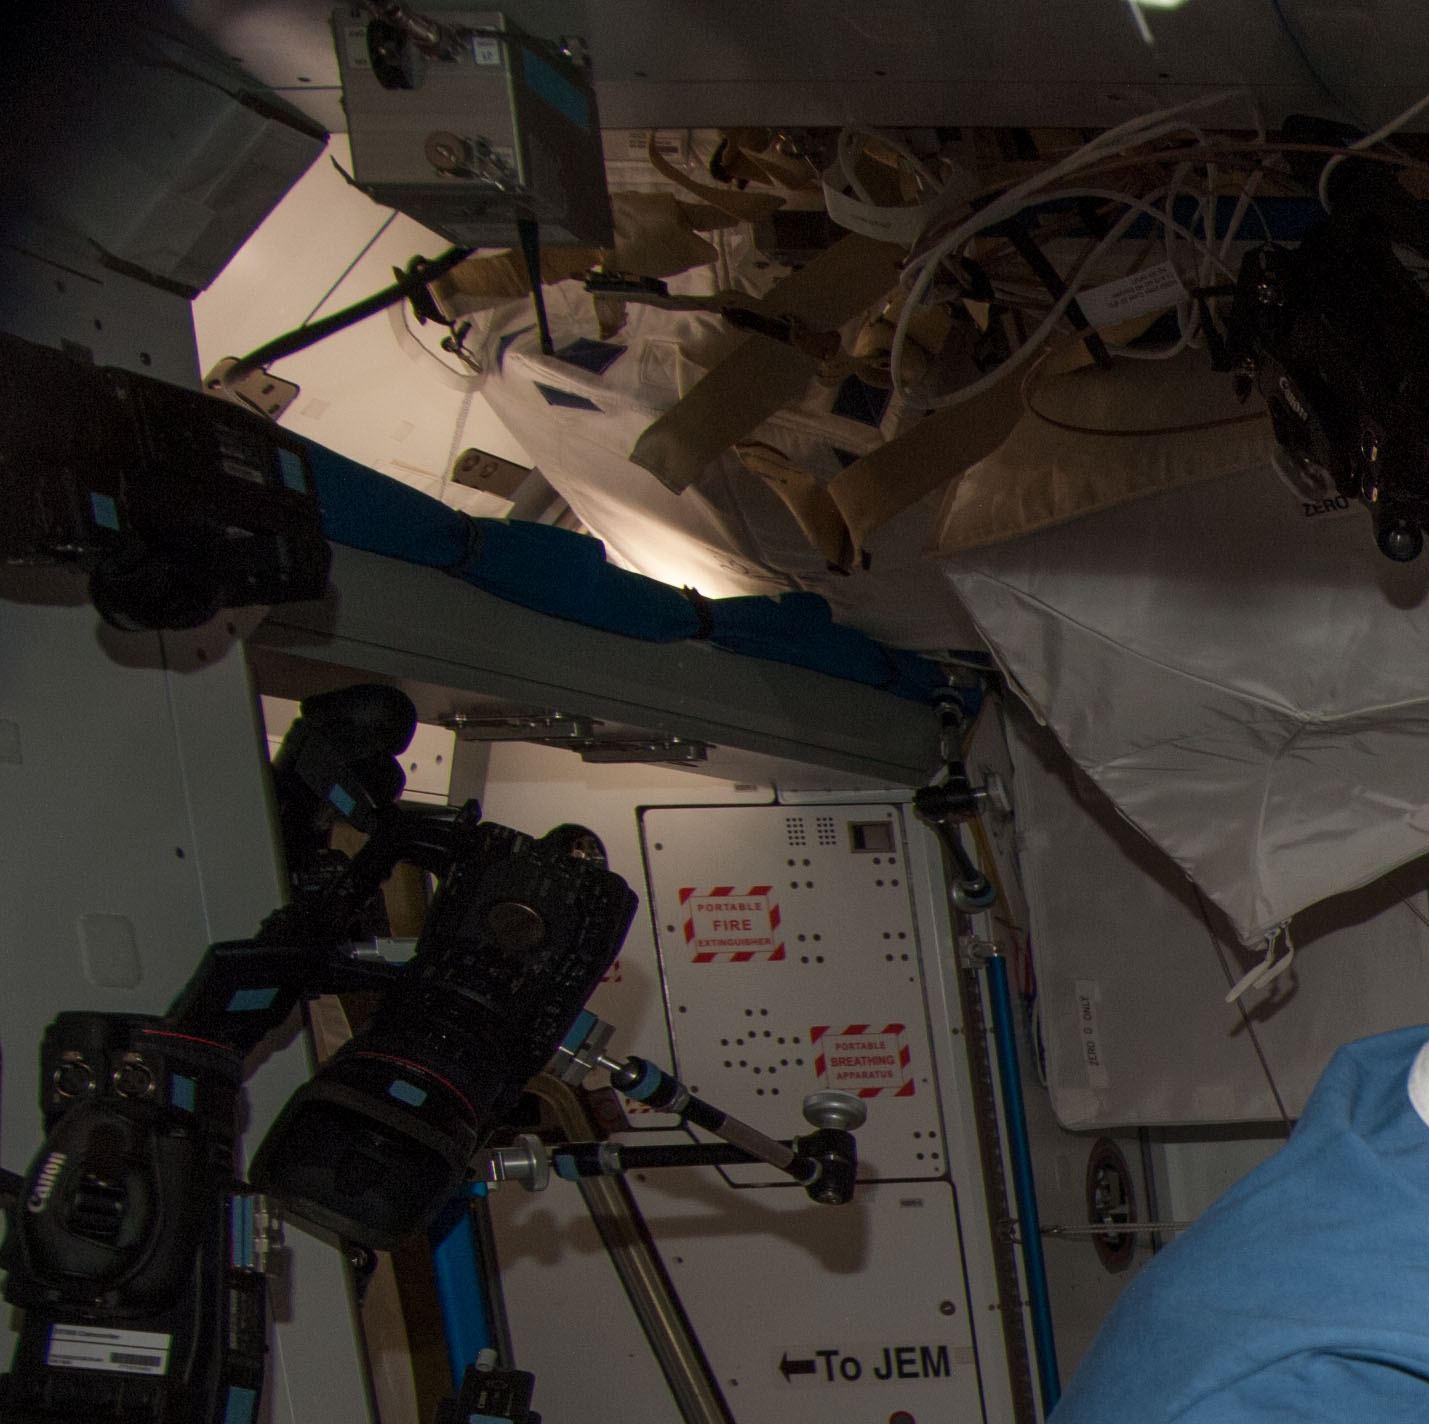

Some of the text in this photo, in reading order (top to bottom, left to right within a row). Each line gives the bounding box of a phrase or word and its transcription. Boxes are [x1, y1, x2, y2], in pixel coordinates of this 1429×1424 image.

[1302, 495, 1349, 518] ZERO
[697, 902, 763, 913] PORTABLE
[713, 919, 753, 932] FIRE
[698, 937, 772, 948] EXTINGUISHER
[1083, 994, 1096, 1019] ONLY
[835, 1040, 886, 1051] PORTABLE
[1088, 1034, 1102, 1067] ZERO
[830, 1055, 895, 1068] BREATHING
[836, 1070, 893, 1080] APPARATUS
[28, 1153, 67, 1212] Canon
[816, 1344, 951, 1384] To JEM
